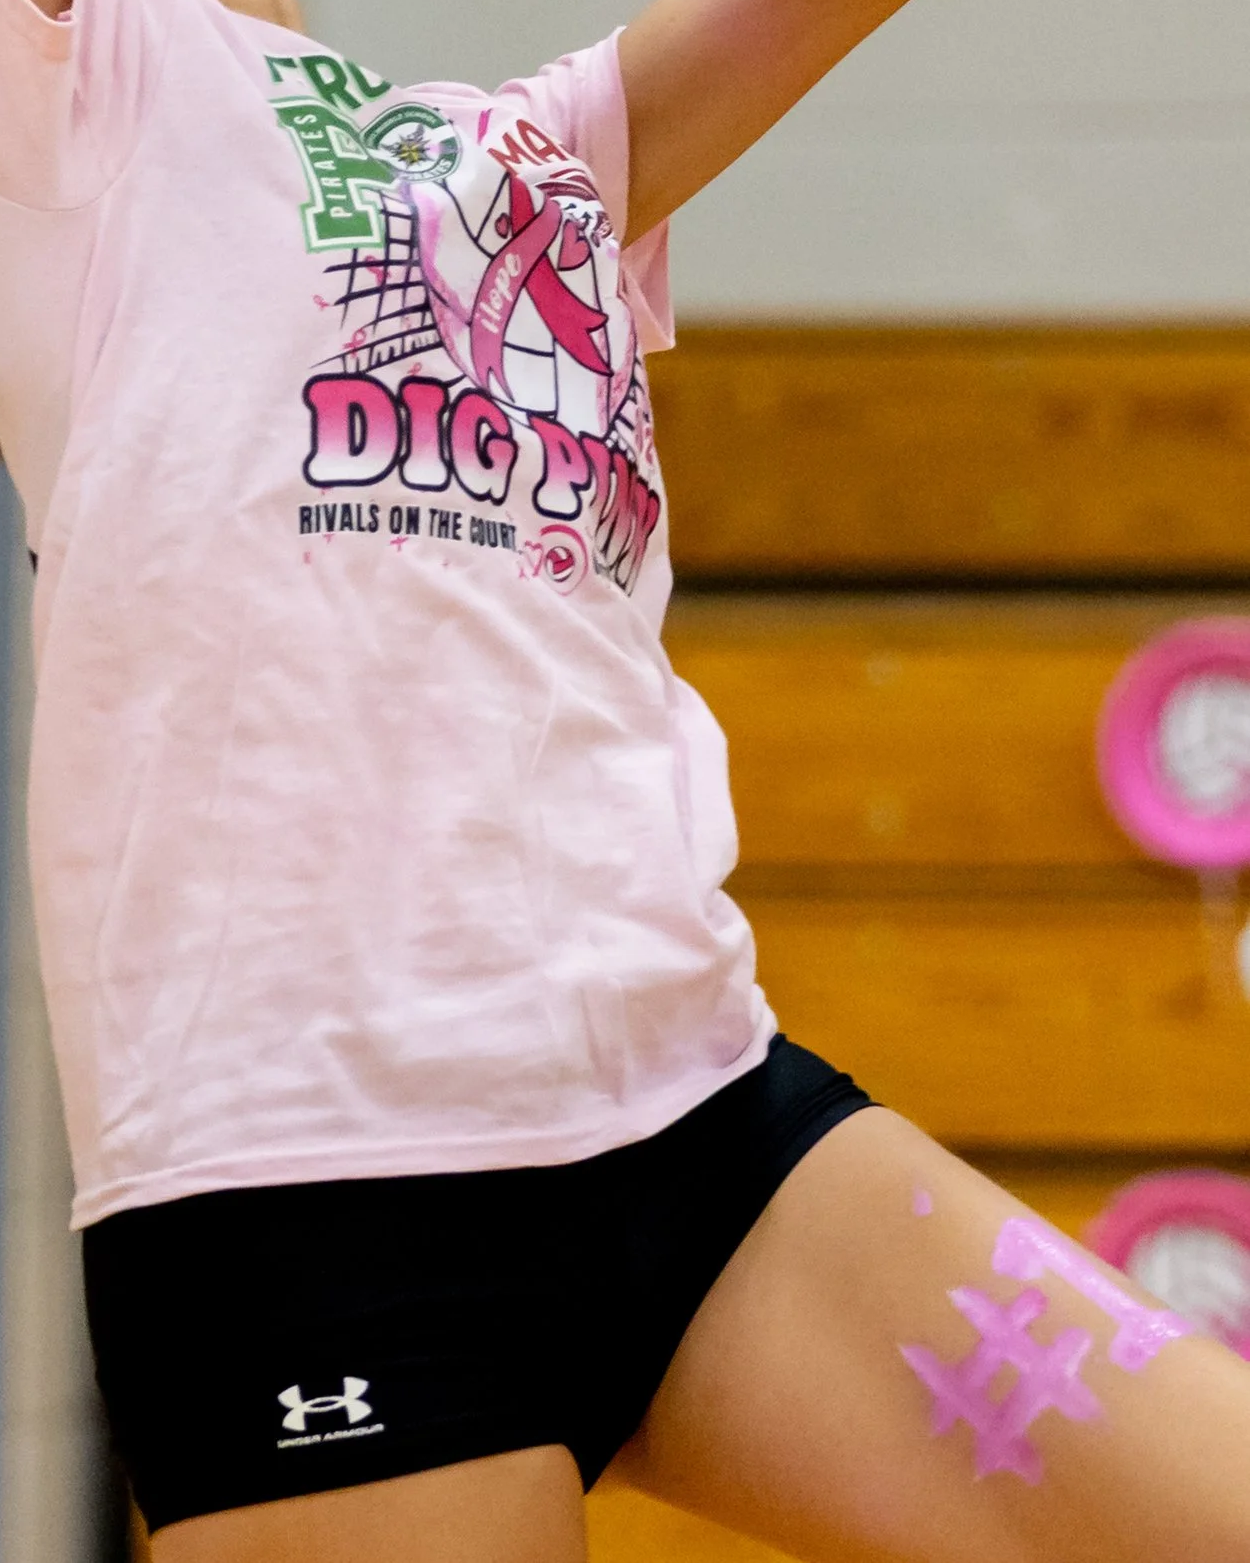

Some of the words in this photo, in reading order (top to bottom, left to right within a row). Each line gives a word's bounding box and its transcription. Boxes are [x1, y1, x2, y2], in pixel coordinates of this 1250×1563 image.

[293, 112, 353, 219] PIRATES
[302, 371, 519, 507] DIG
[299, 502, 380, 536] RIVALS
[388, 505, 421, 536] ON
[428, 507, 463, 541] THE
